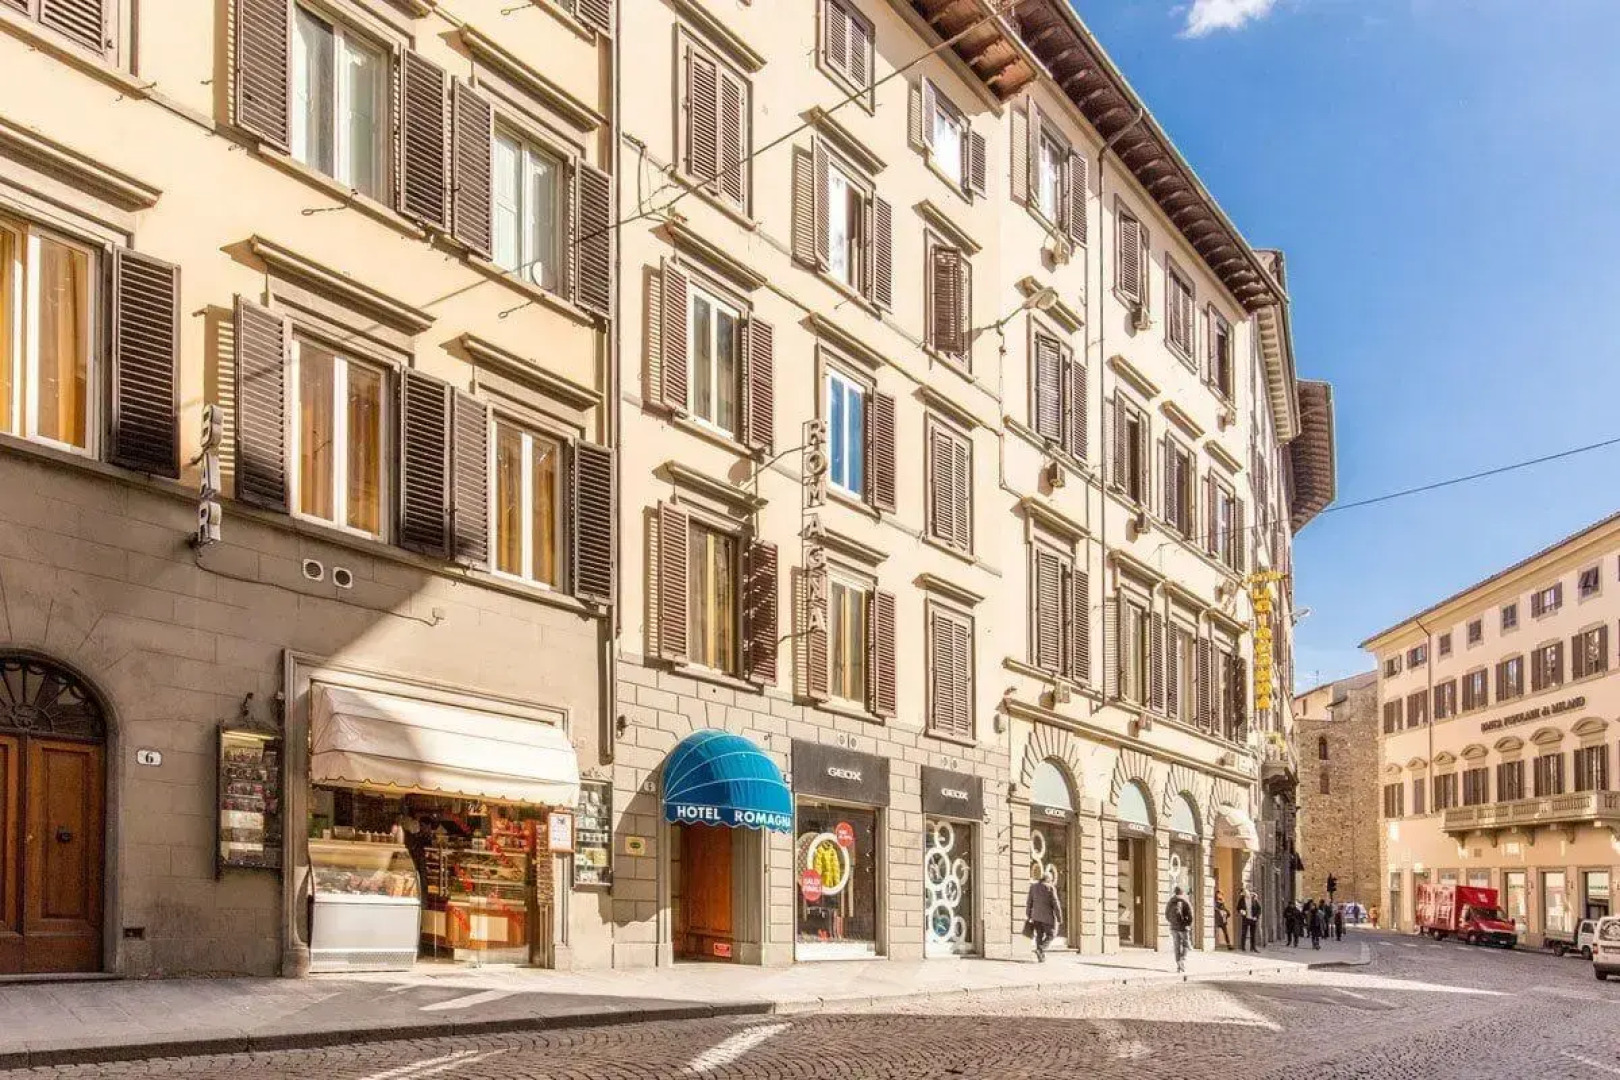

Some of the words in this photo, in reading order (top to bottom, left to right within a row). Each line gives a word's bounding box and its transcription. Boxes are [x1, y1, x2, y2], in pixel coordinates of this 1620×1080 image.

[806, 419, 827, 632] ROMAGNA
[145, 752, 154, 764] 6
[828, 767, 861, 780] GEOX
[941, 788, 968, 800] GEOX
[677, 806, 721, 820] HOTEL
